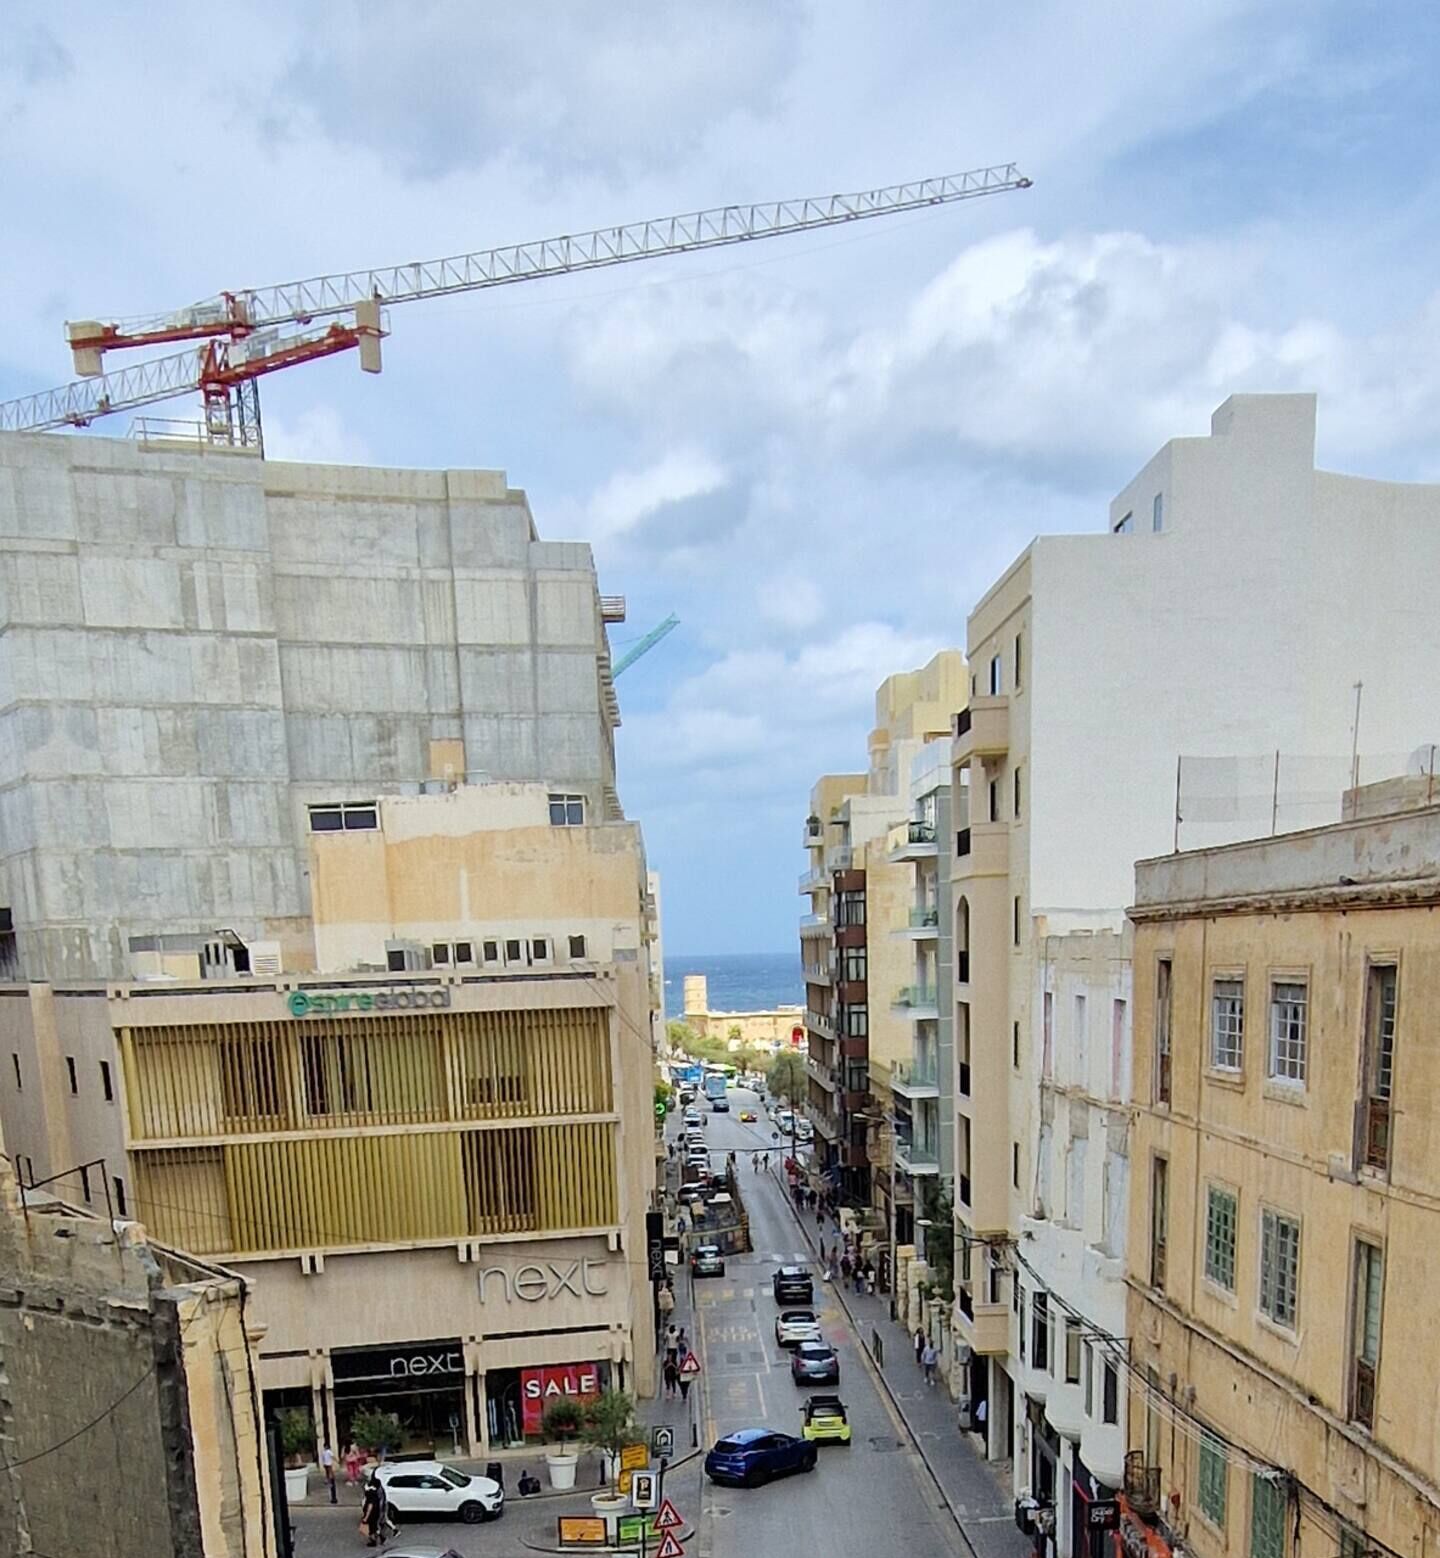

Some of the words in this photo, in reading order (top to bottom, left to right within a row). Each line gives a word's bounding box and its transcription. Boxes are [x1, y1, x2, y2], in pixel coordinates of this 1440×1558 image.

[651, 1240, 664, 1278] next
[479, 1256, 609, 1305] next
[390, 1353, 464, 1378] next
[525, 1375, 595, 1399] SALE
